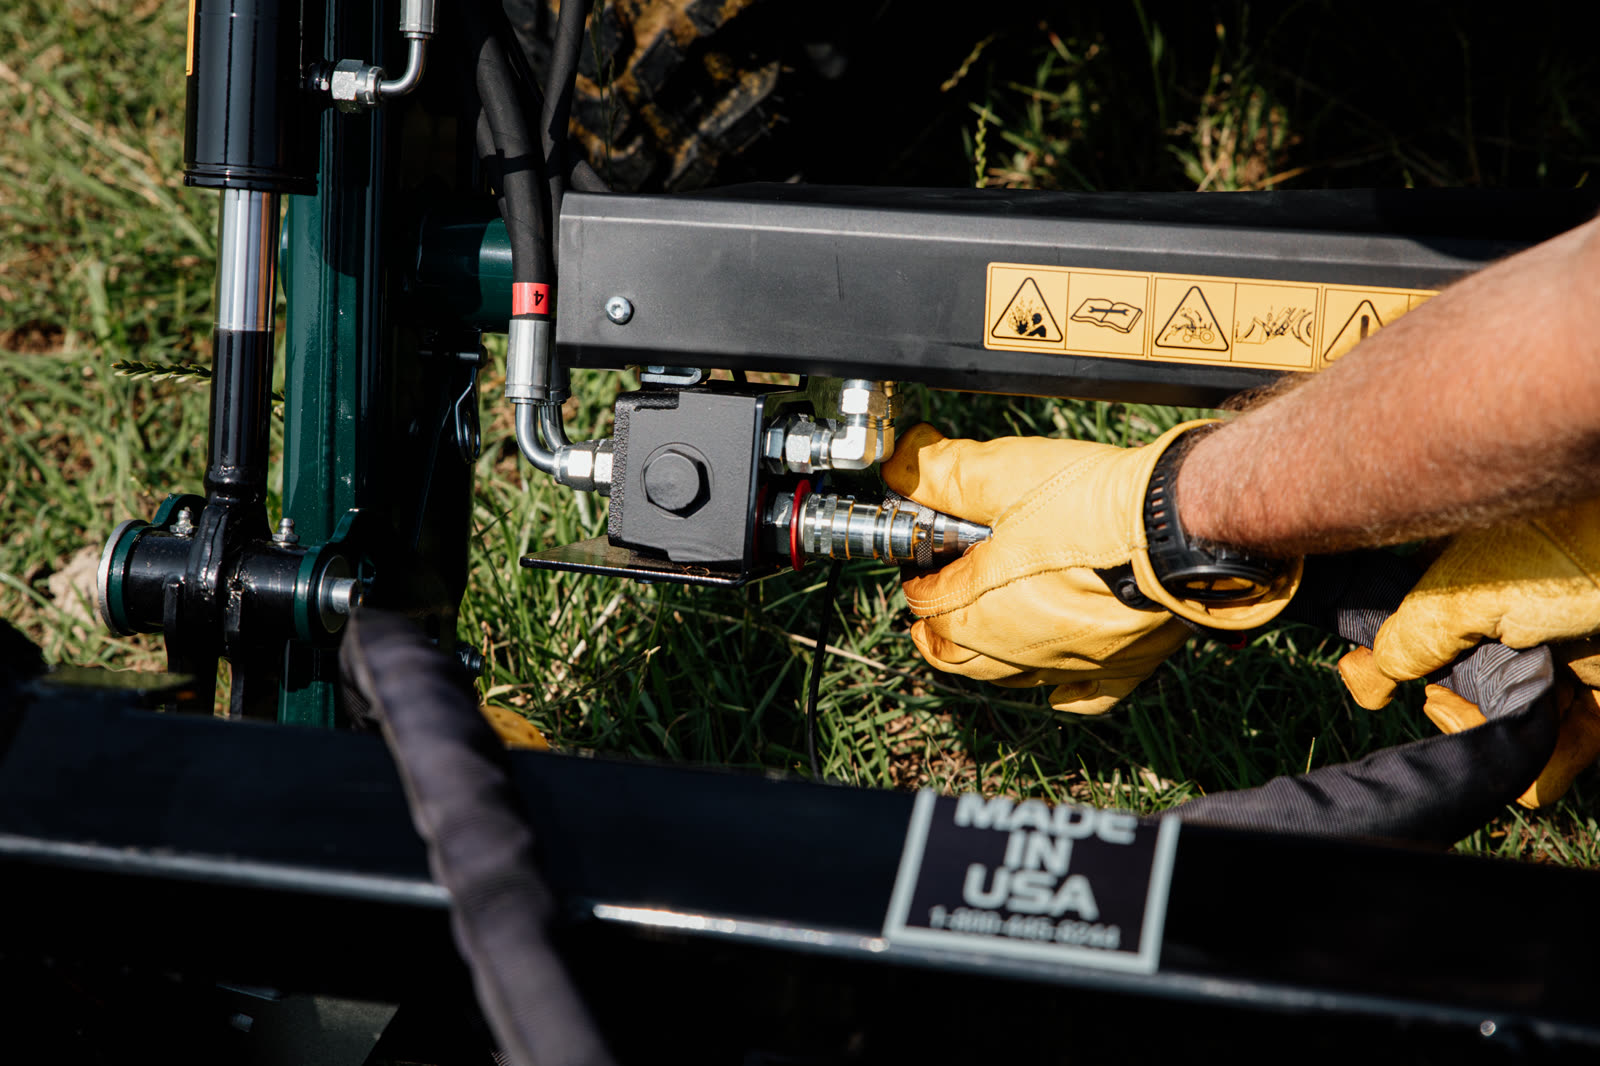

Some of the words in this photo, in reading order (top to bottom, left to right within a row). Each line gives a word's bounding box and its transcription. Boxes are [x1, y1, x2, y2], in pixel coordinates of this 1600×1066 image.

[533, 290, 545, 307] 4
[954, 792, 1138, 846] MADE
[1003, 829, 1074, 878] IN
[963, 862, 1099, 922] USA
